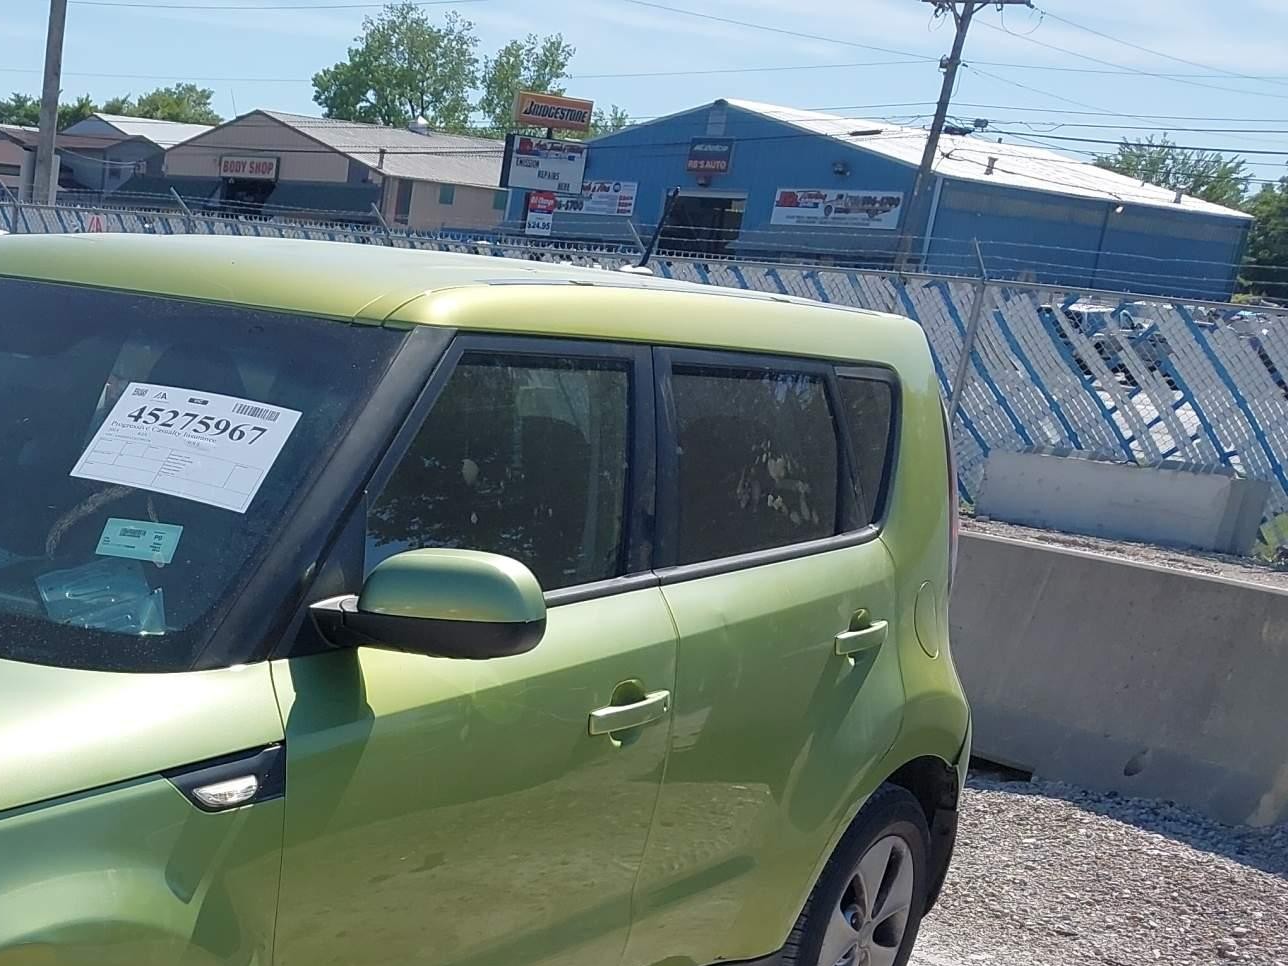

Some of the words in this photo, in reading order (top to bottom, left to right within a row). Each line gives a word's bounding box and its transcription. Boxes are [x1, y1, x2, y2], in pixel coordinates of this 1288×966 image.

[524, 101, 589, 123] BRIDGESTONE
[223, 160, 247, 173] BODY
[249, 160, 274, 175] SHOP
[515, 157, 540, 169] EMISSION
[705, 160, 727, 170] AUTO
[536, 170, 560, 181] REPAIRS
[110, 420, 150, 432] Progressive
[151, 426, 182, 438] Casualty
[183, 431, 218, 443] Insurance
[127, 405, 268, 446] 45275967
